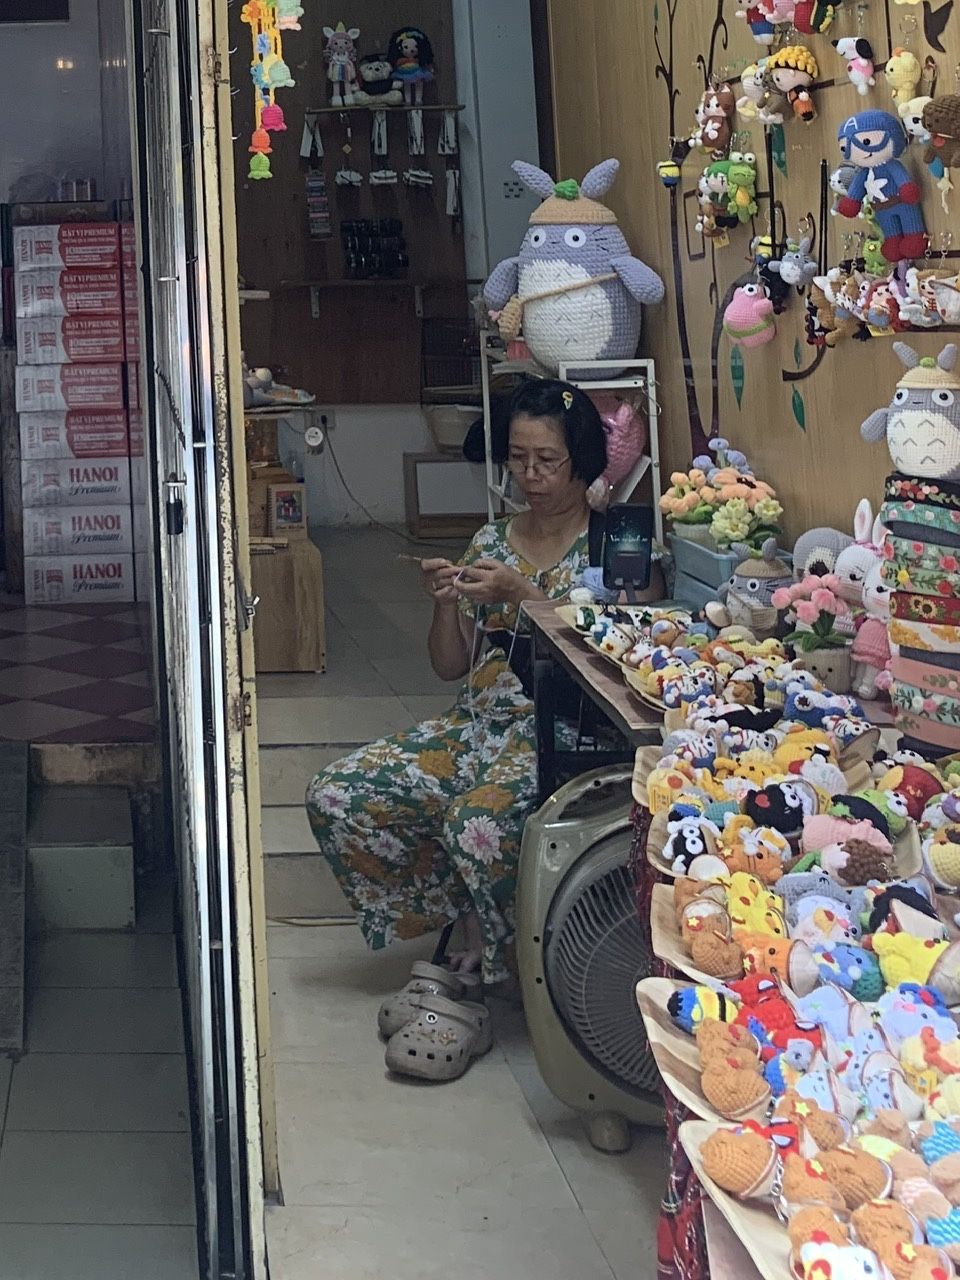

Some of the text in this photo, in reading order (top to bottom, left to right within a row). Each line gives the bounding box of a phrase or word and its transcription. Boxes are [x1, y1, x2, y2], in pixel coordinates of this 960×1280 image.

[69, 466, 119, 482] HANOI
[71, 514, 121, 531] HANOI
[72, 562, 123, 580] HANOI
